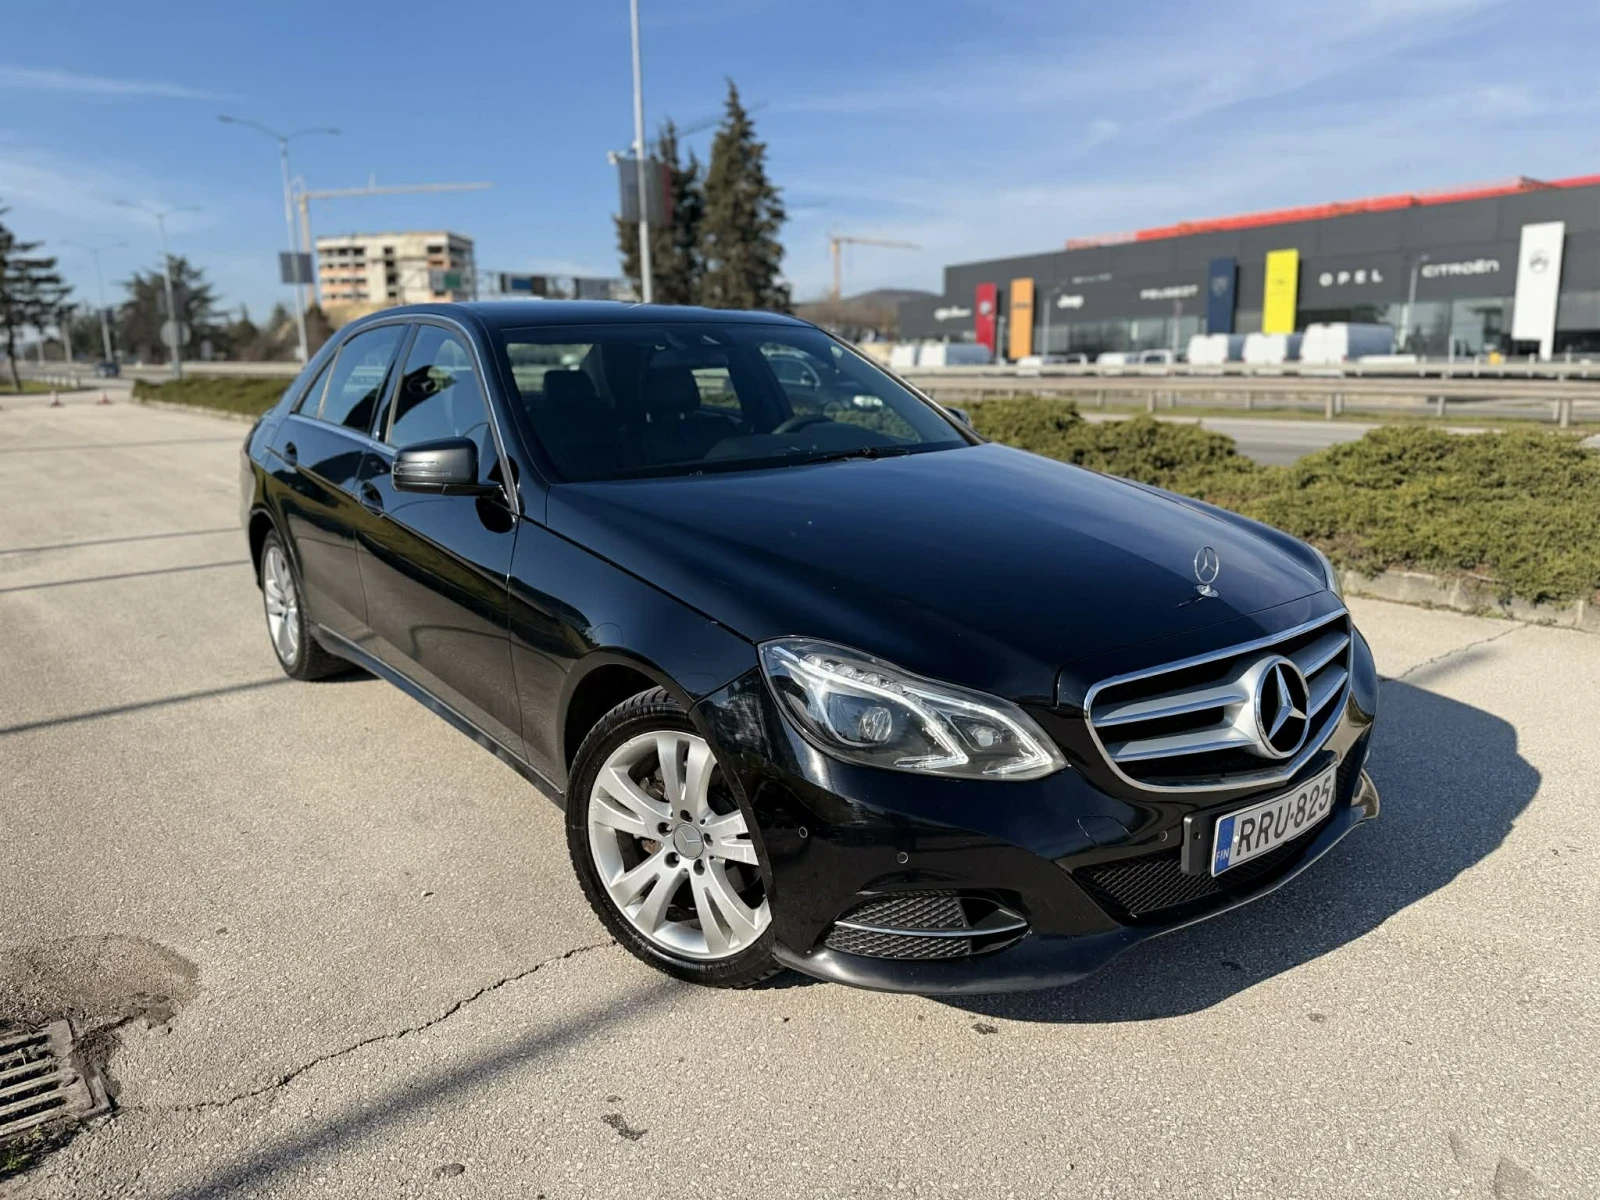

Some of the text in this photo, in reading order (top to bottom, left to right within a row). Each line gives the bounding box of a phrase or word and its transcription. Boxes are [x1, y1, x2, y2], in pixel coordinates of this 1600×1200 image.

[1319, 268, 1383, 287] OPEL
[1237, 775, 1332, 856] RRU-825
[1215, 847, 1230, 863] FIN
